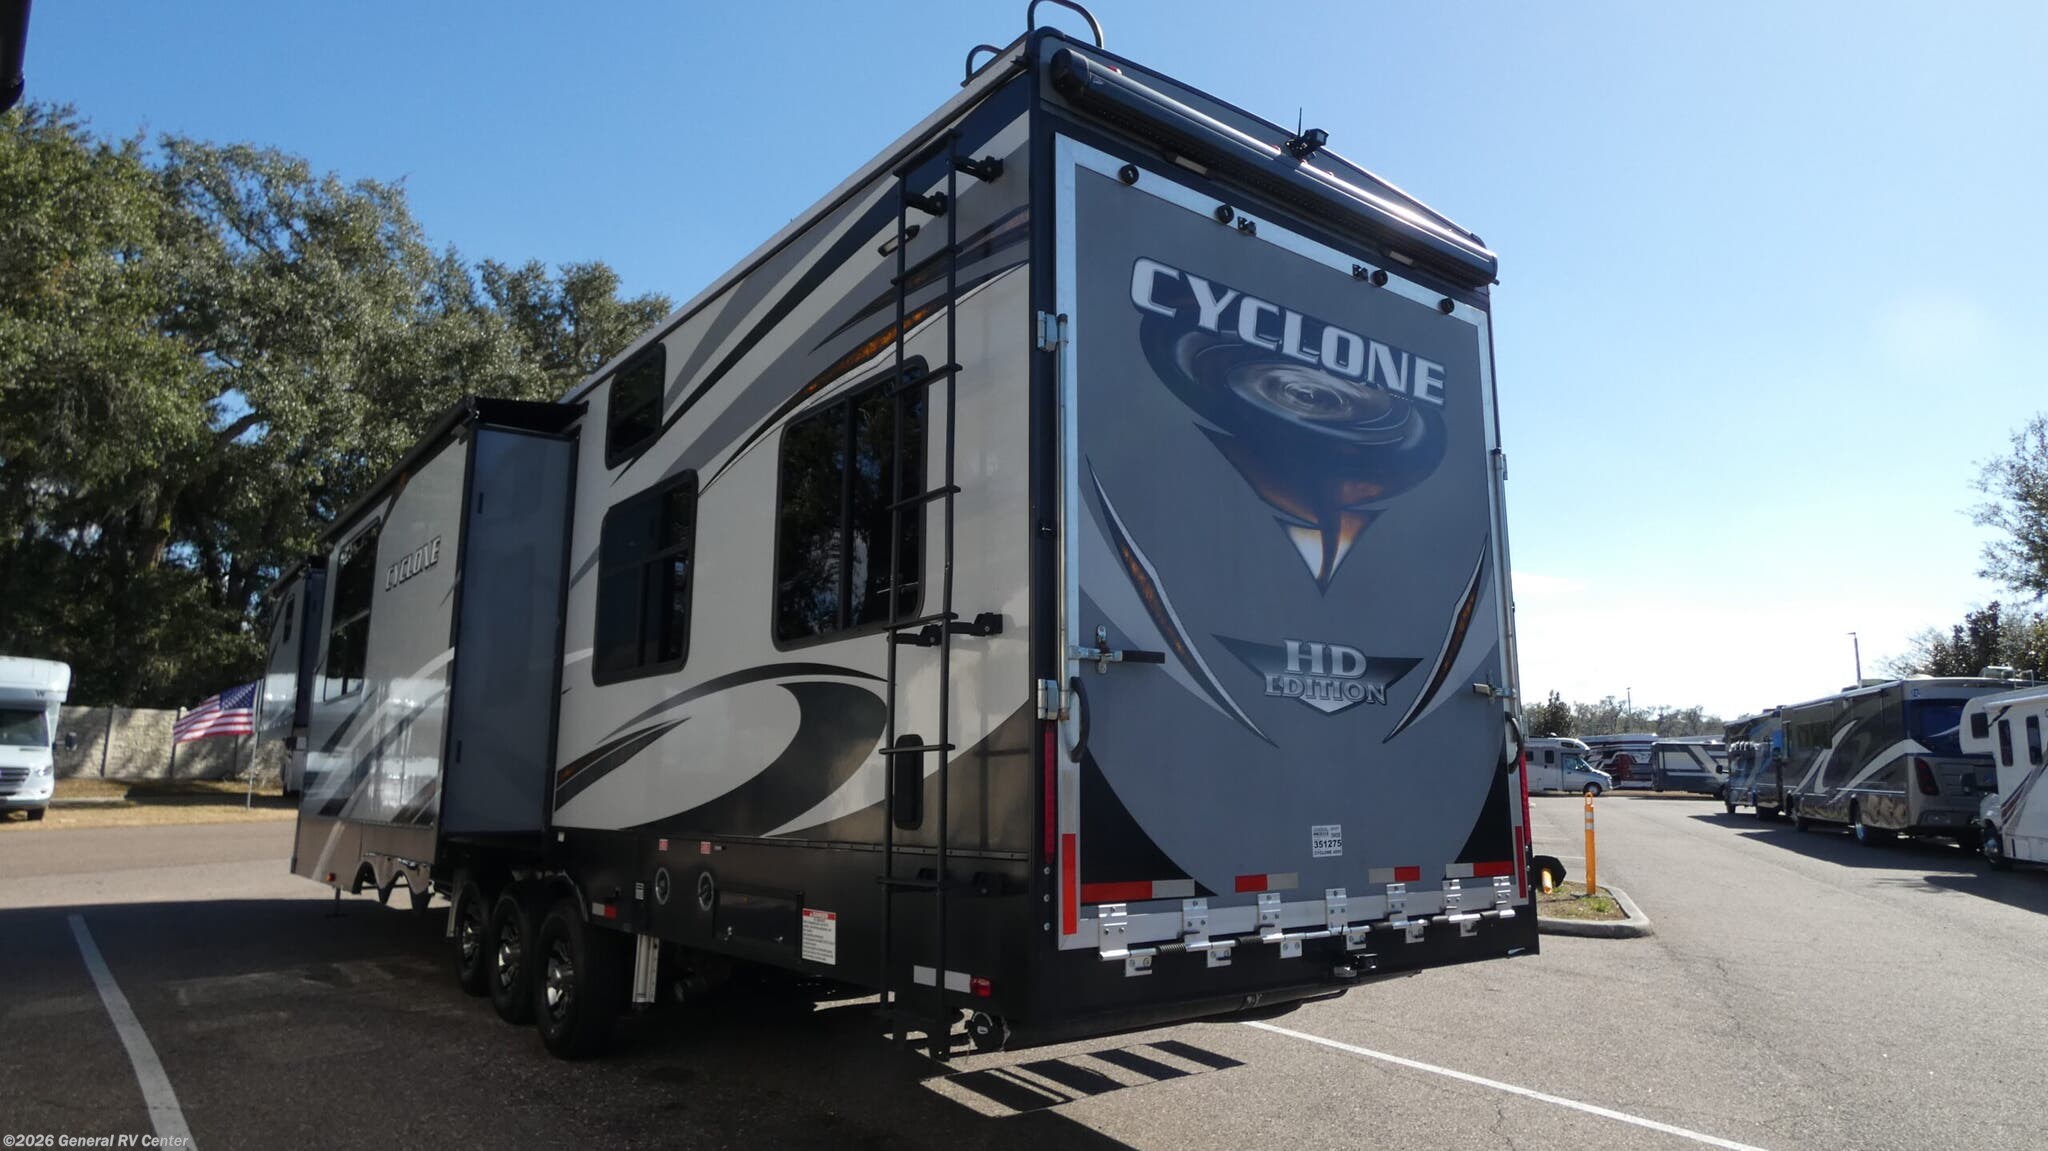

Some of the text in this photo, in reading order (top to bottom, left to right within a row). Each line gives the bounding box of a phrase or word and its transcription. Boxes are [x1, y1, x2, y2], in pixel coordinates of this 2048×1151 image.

[1131, 256, 1446, 405] CYCLONE
[385, 535, 441, 592] CYCLONE
[1283, 638, 1367, 679] HD
[1264, 673, 1388, 705] EDITION
[1313, 839, 1343, 849] 351275
